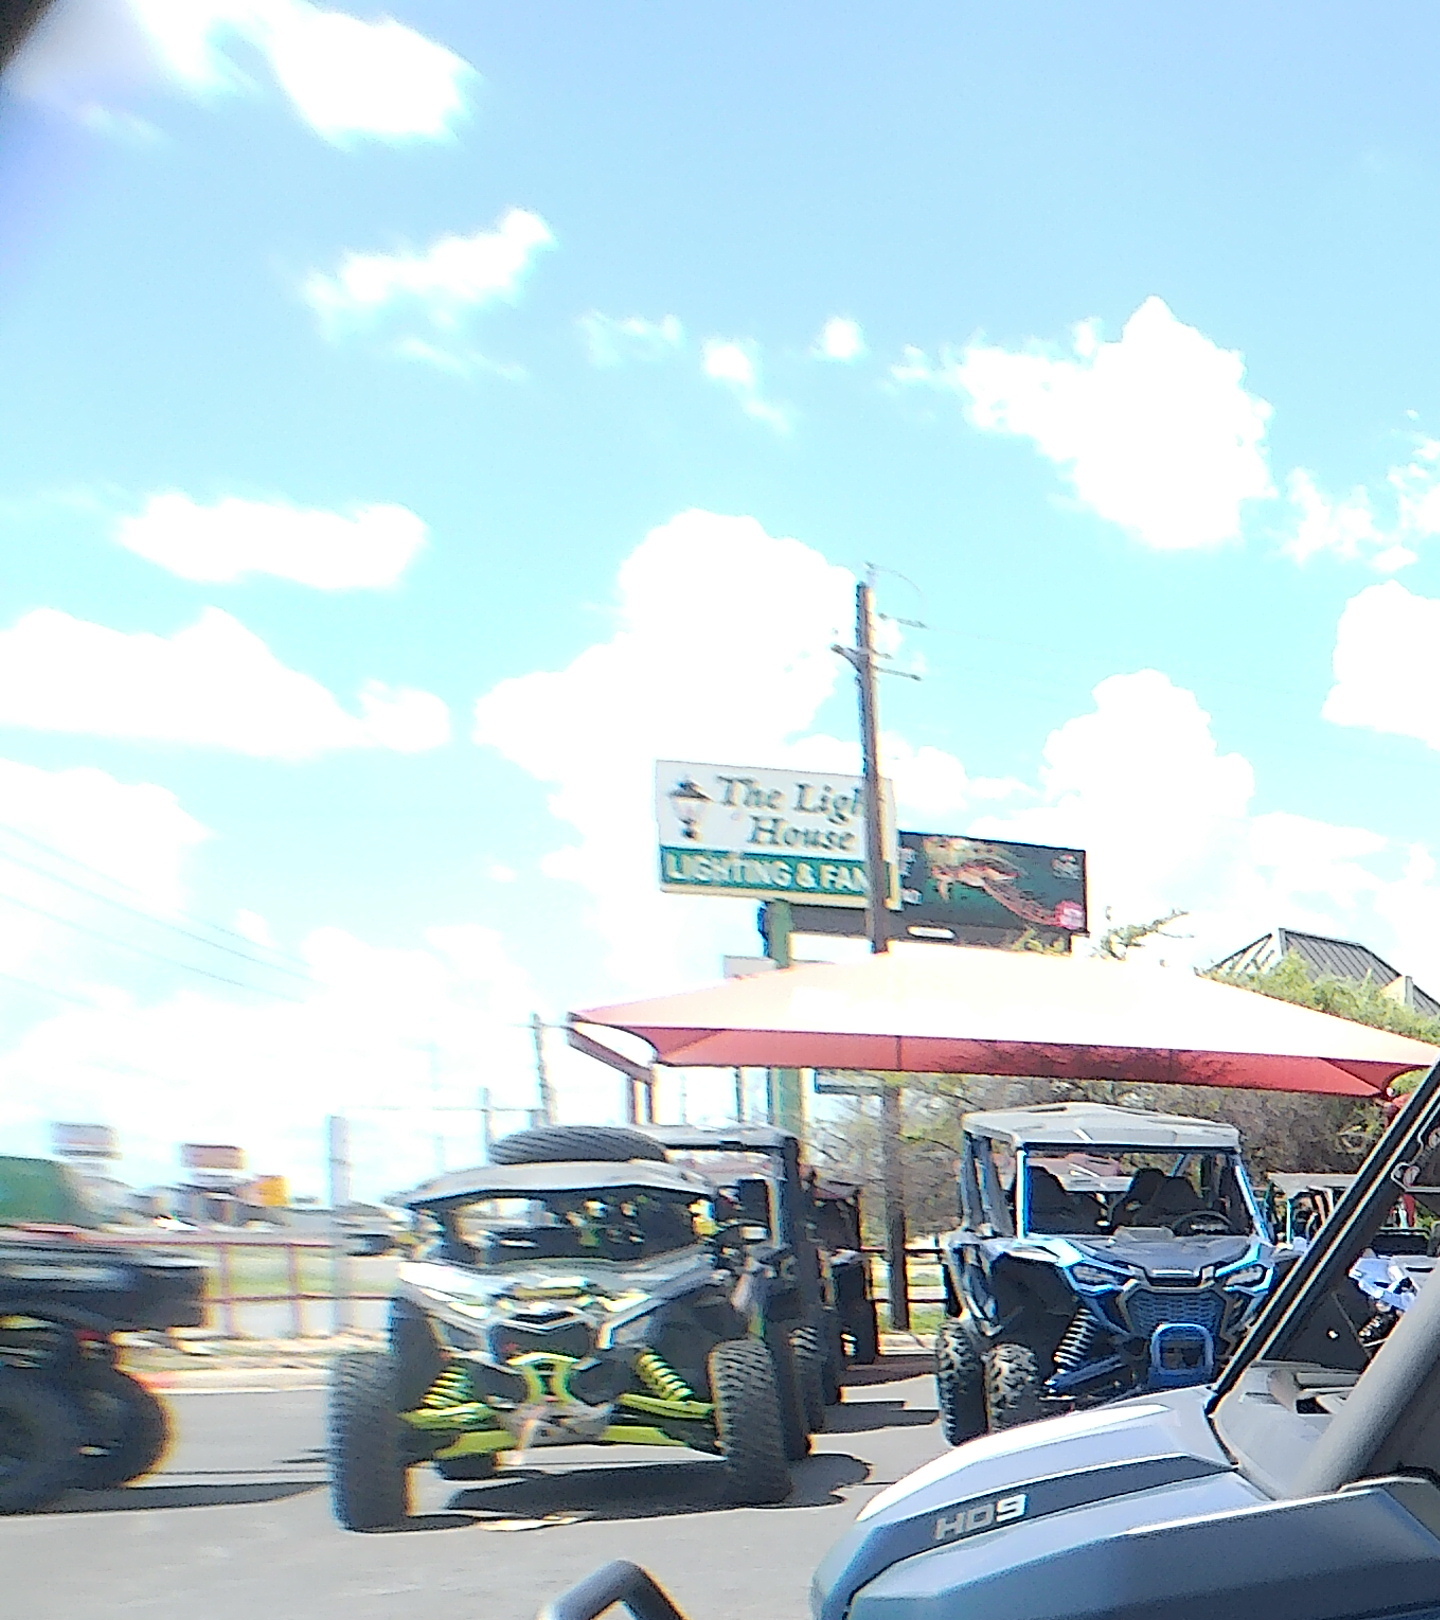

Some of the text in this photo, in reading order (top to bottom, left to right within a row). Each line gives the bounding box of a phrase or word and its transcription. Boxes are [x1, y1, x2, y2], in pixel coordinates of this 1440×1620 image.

[717, 774, 784, 810] The
[748, 814, 857, 850] House
[663, 853, 793, 889] LIGHTING
[795, 861, 818, 890] &
